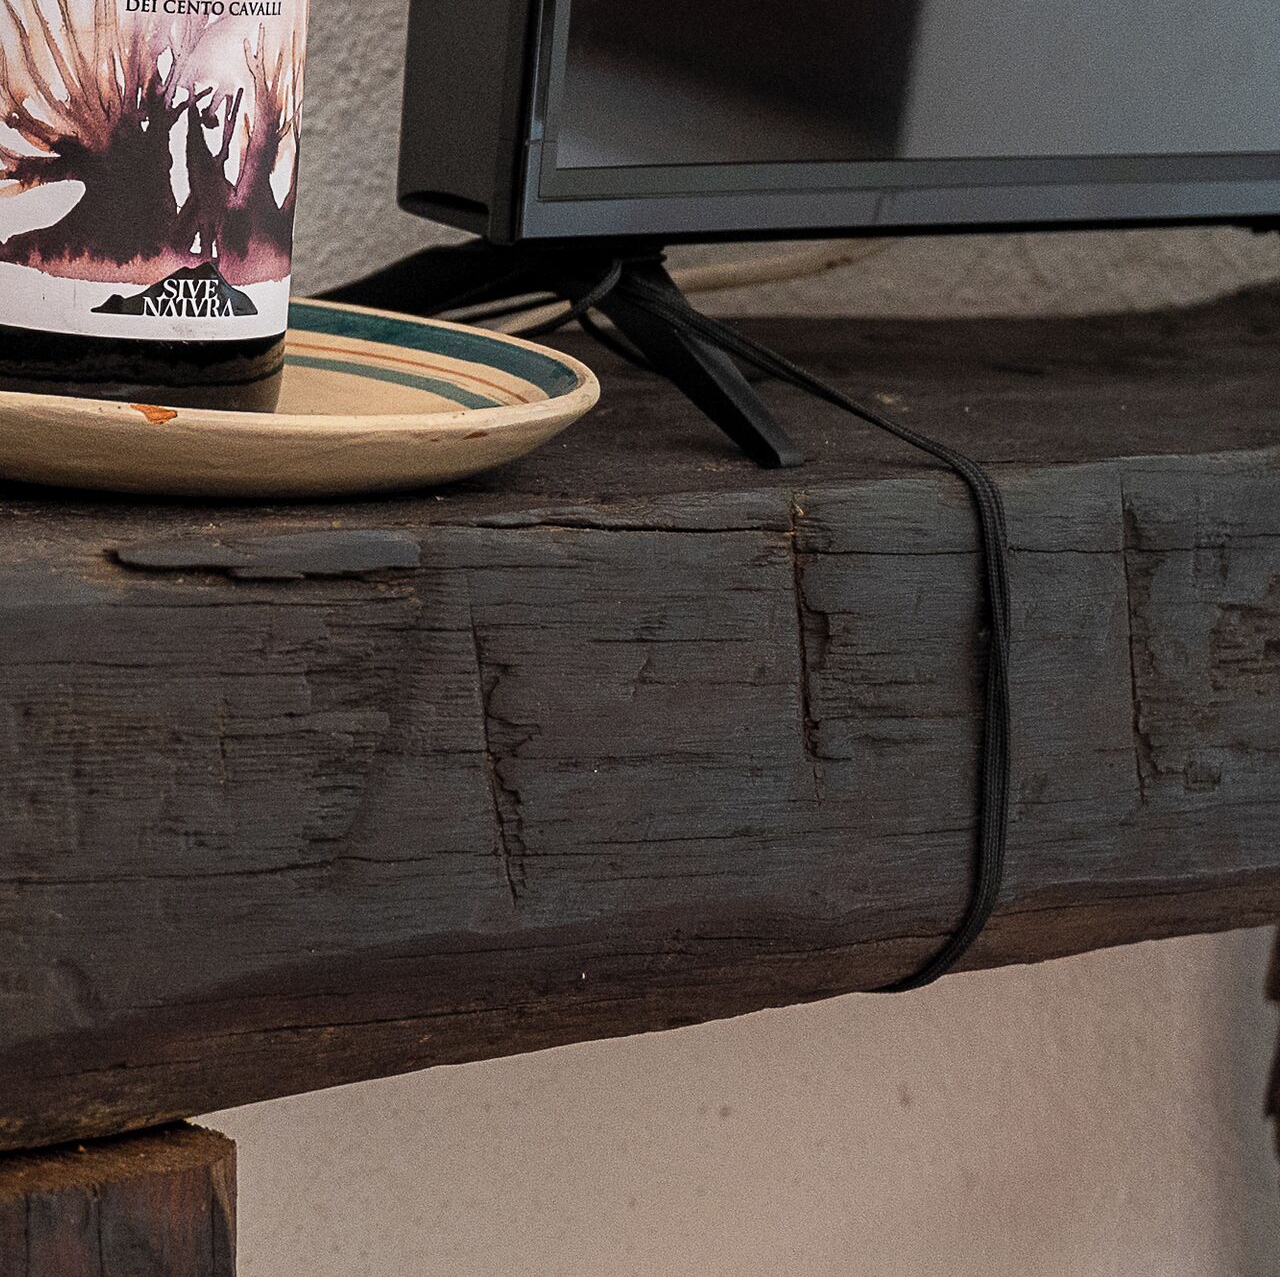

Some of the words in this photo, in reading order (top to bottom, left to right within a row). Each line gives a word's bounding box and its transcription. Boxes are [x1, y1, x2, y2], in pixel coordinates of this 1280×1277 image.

[163, 0, 225, 16] CENTO
[229, 2, 282, 16] CAVALLI
[161, 279, 219, 299] SIVE
